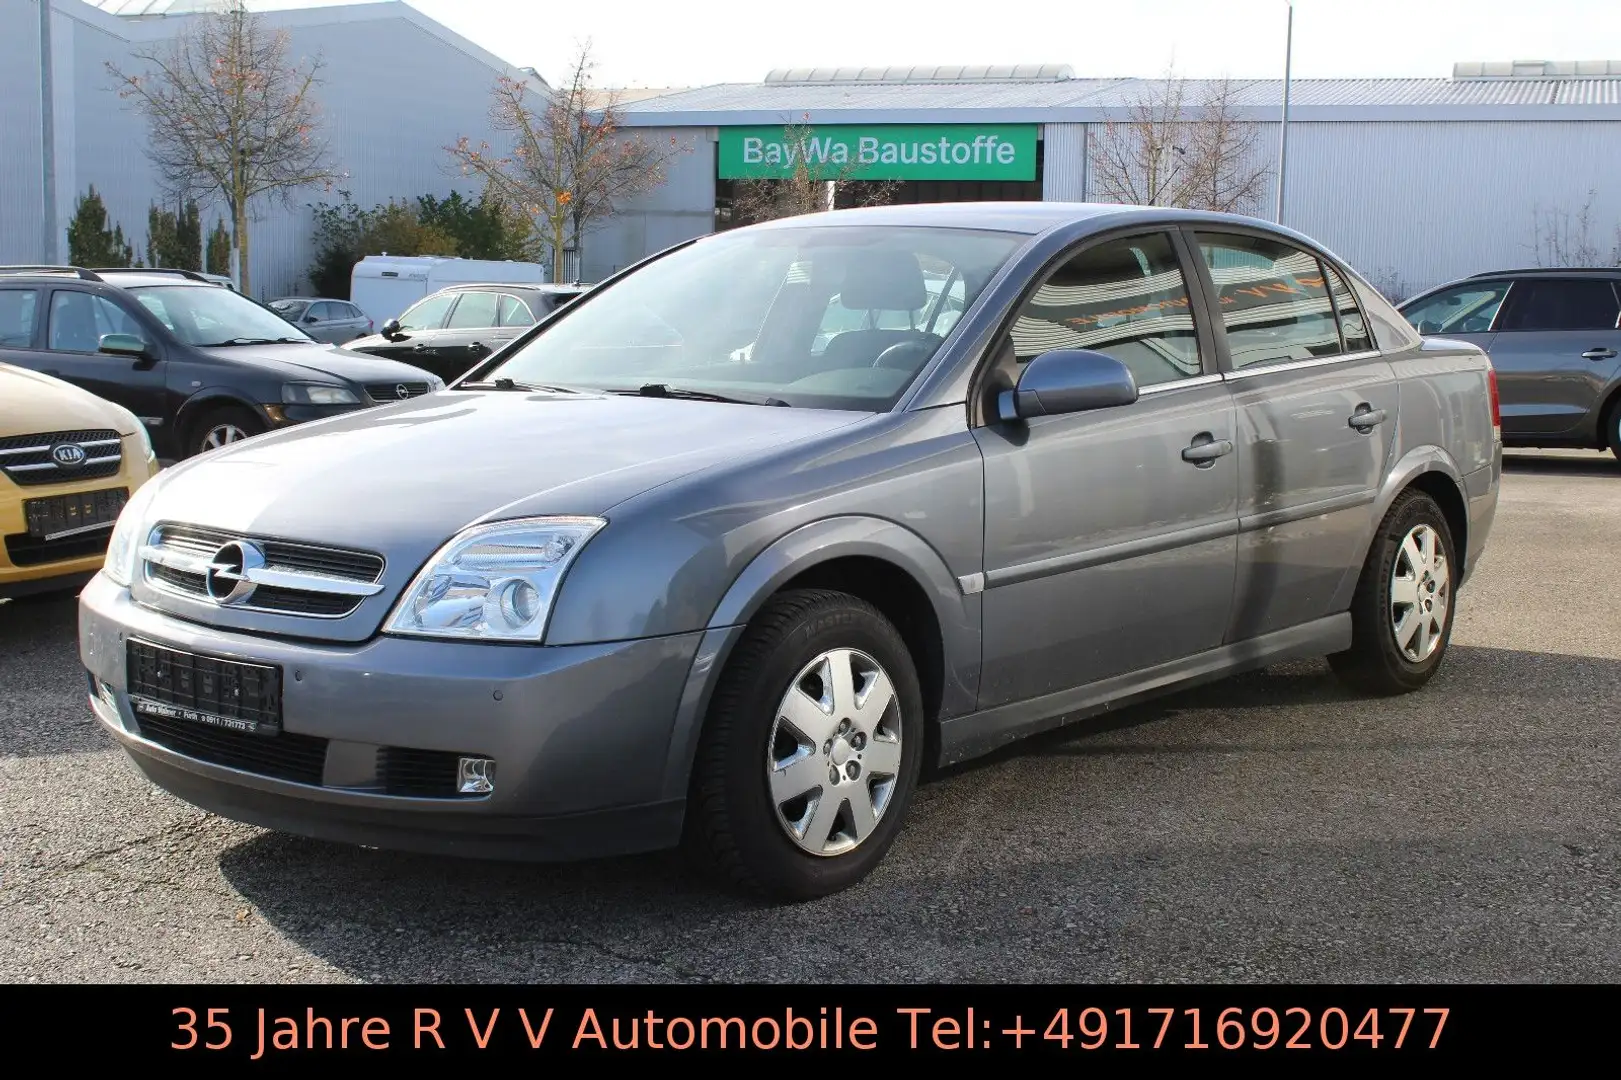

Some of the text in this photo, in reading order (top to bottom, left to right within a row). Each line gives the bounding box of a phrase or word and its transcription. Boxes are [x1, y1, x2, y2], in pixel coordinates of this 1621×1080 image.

[743, 135, 1016, 169] BayWa Baustoffe
[58, 447, 82, 461] KIA
